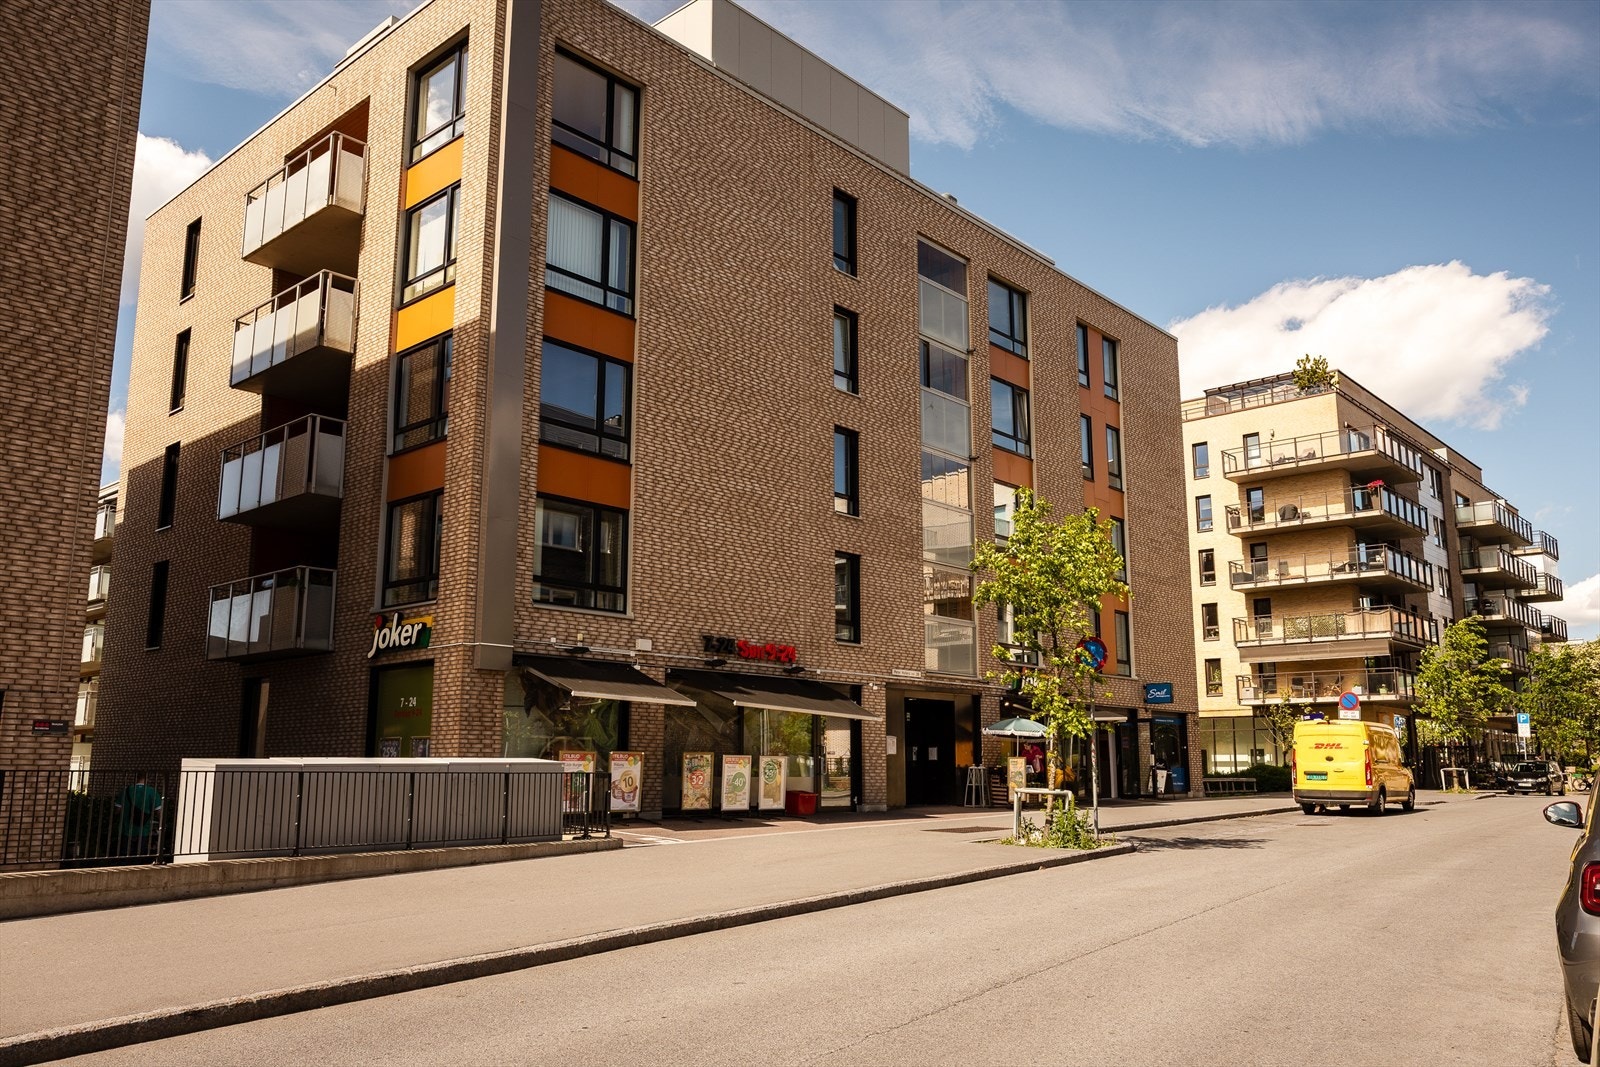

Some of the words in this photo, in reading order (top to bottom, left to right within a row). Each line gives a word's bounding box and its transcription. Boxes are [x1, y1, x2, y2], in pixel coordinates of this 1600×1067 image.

[367, 613, 422, 658] joker
[1520, 714, 1527, 723] P
[622, 775, 634, 788] 10
